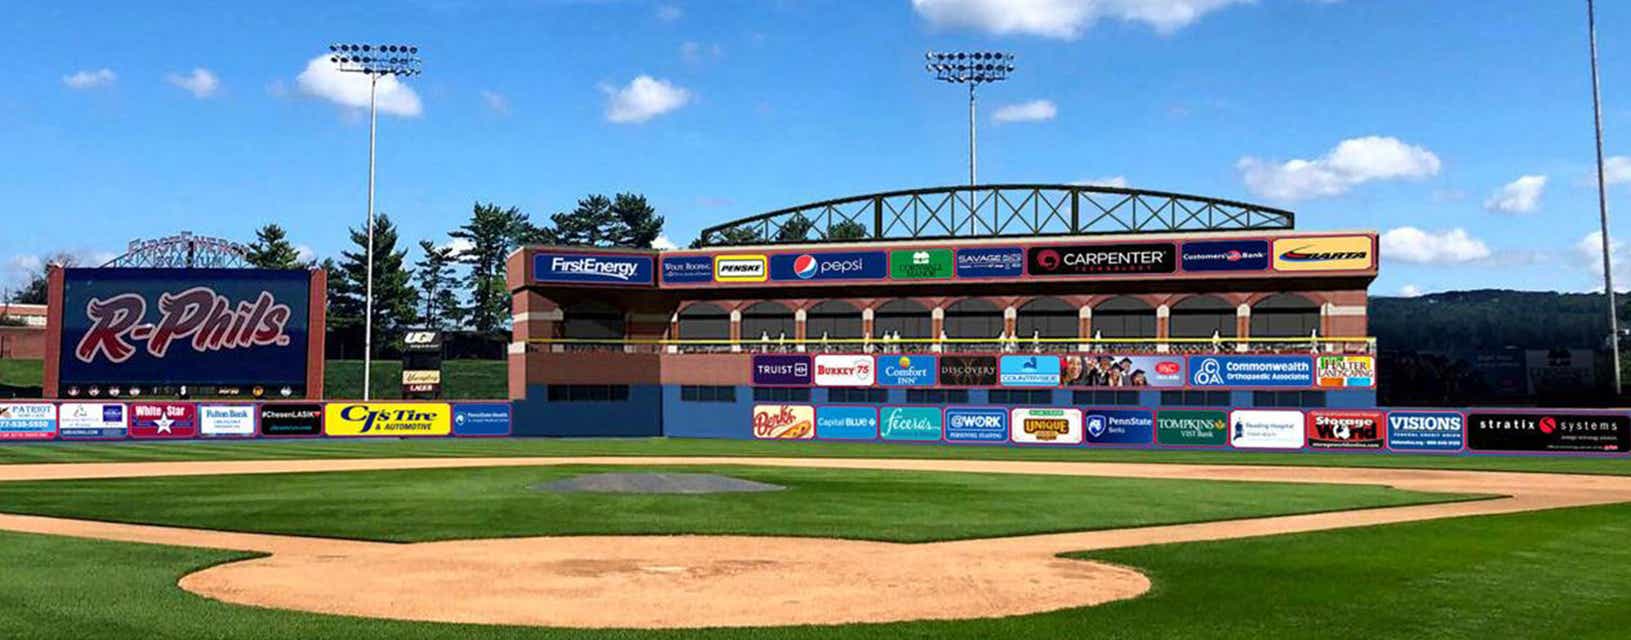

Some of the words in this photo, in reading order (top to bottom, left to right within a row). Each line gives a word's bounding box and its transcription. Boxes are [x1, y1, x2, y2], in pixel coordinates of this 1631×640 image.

[957, 254, 1002, 264] SAVAGE
[1063, 250, 1163, 265] CARPENTER
[1241, 251, 1263, 259] Bank
[551, 256, 638, 276] FirstEnergy
[720, 264, 762, 273] PENSKE
[820, 258, 864, 274] pepsi
[404, 332, 436, 344] UGI
[757, 365, 793, 375] TRUIST
[856, 365, 870, 374] 75
[885, 366, 927, 377] Comfort
[941, 366, 995, 376] DISCOVERY
[1226, 361, 1309, 372] Commonwealth
[1226, 373, 1270, 381] Orthopaedic
[1271, 373, 1310, 381] Associates
[12, 405, 51, 413] PATRIOT
[136, 405, 162, 417] White
[166, 405, 186, 417] Star
[229, 409, 248, 418] Bank
[393, 409, 438, 422] Tire
[383, 423, 432, 431] AUTOMOTIVE
[817, 417, 844, 427] Capital
[950, 415, 1002, 428] @WORK
[1025, 419, 1069, 434] UNIQUE
[1108, 417, 1152, 427] PennState
[1158, 418, 1216, 431] TOMPKINS
[1316, 416, 1374, 430] Storage
[1390, 416, 1461, 431] VISIONS
[1480, 418, 1535, 430] stratix
[1560, 420, 1618, 432] systems
[1198, 430, 1214, 438] Bank
